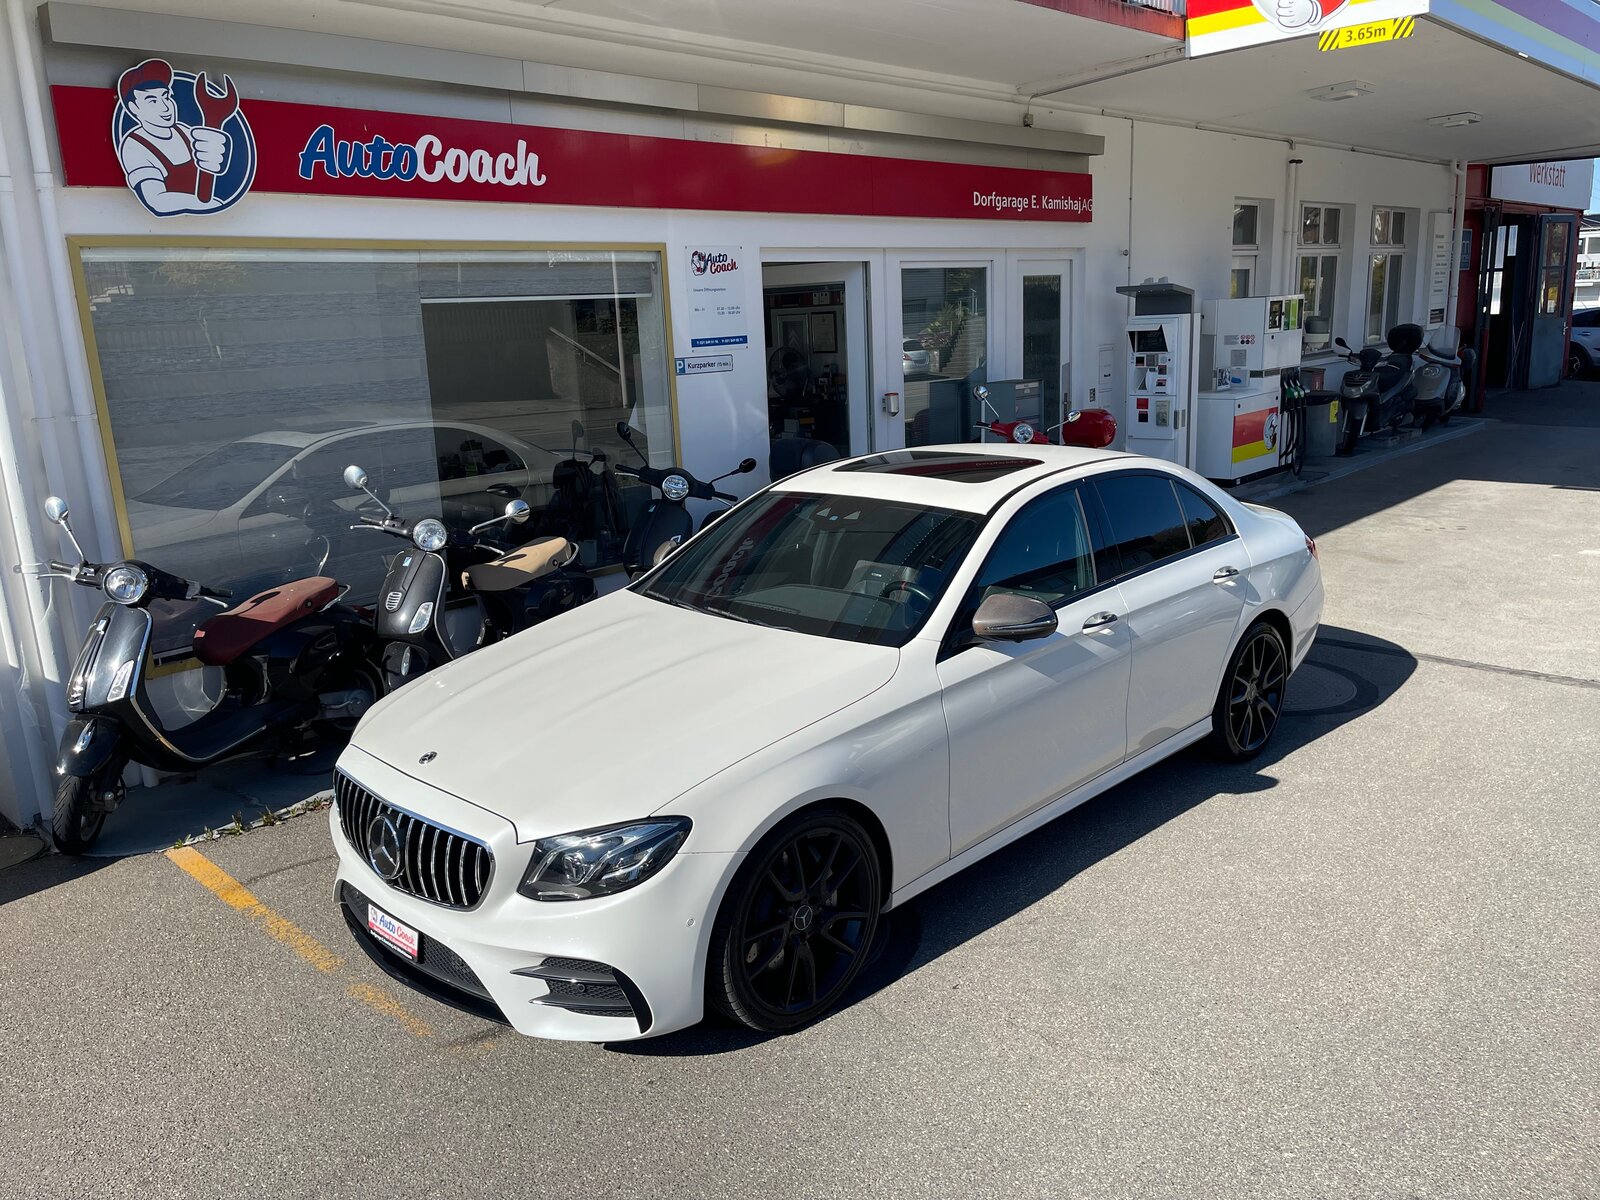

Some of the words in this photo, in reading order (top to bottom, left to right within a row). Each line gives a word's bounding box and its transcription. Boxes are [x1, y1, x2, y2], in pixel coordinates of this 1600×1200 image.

[1345, 26, 1386, 43] 3.65m
[1529, 162, 1566, 188] Werkstatt
[973, 191, 1029, 212] Dorfgarage
[1031, 195, 1040, 209] E.
[1042, 195, 1081, 214] Kamishaj
[706, 252, 728, 264] Auto
[710, 258, 738, 275] Coach
[687, 361, 716, 370] Kurzparker
[379, 915, 396, 934] Auto
